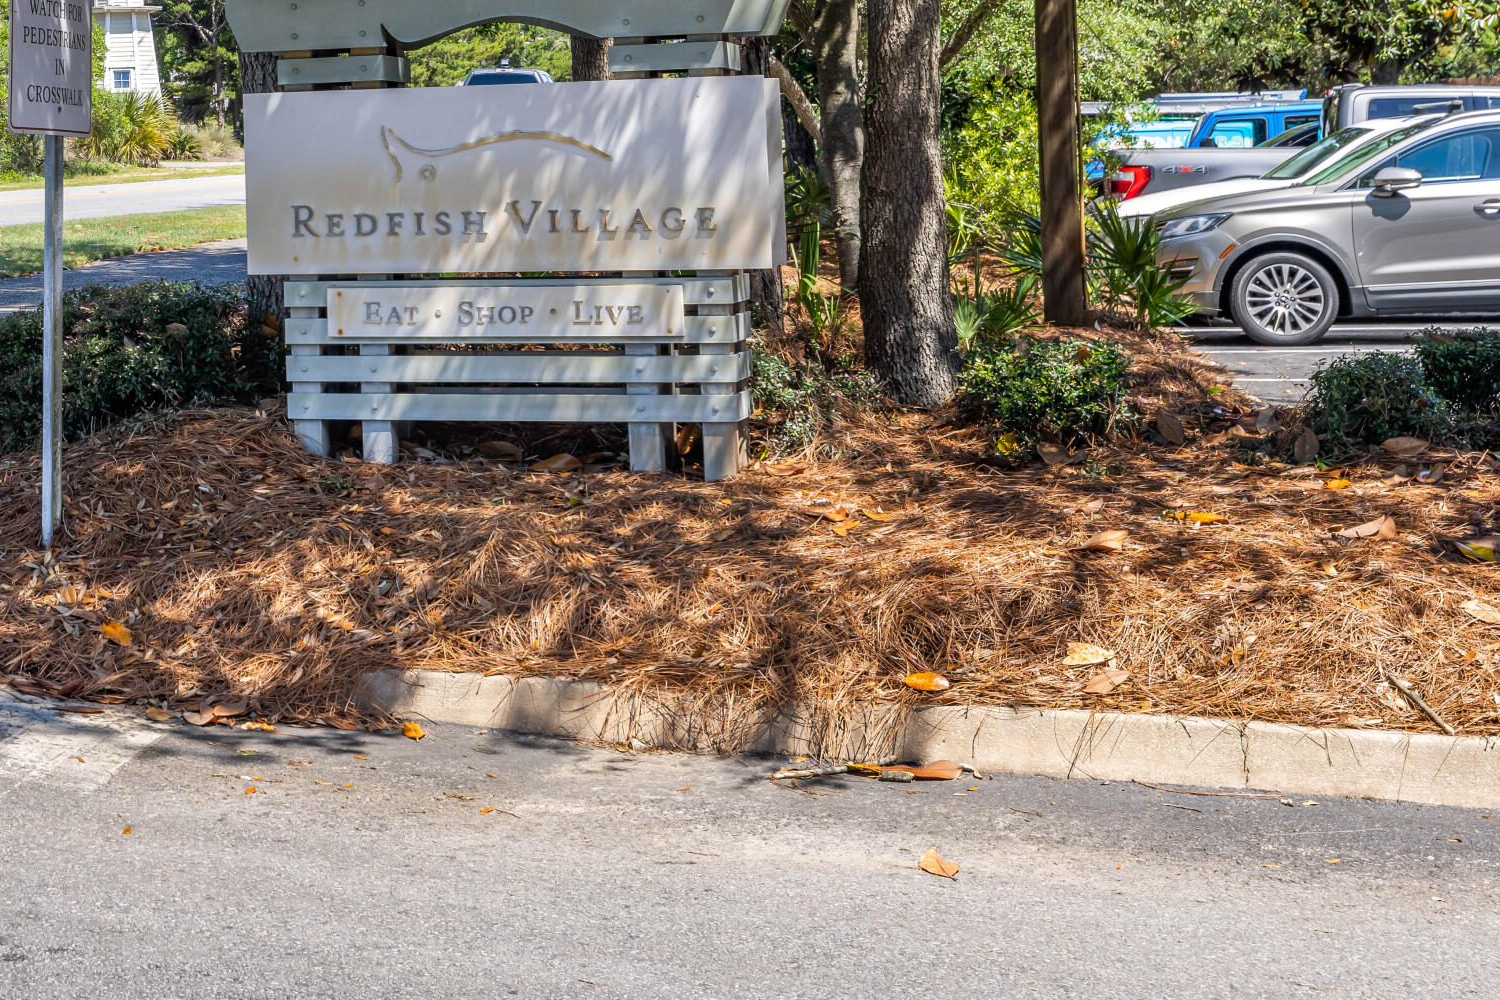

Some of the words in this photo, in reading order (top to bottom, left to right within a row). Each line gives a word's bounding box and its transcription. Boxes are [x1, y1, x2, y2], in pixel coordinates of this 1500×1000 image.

[68, 3, 83, 23] FOR
[23, 25, 86, 51] PEDESTRIANS
[55, 58, 65, 76] IN
[27, 84, 83, 107] CROSSWALK
[291, 204, 488, 238] REDFISH
[504, 200, 717, 236] VILLAGE
[363, 301, 419, 326] EAT
[457, 300, 533, 326] SHOP
[572, 300, 644, 326] LIVE
